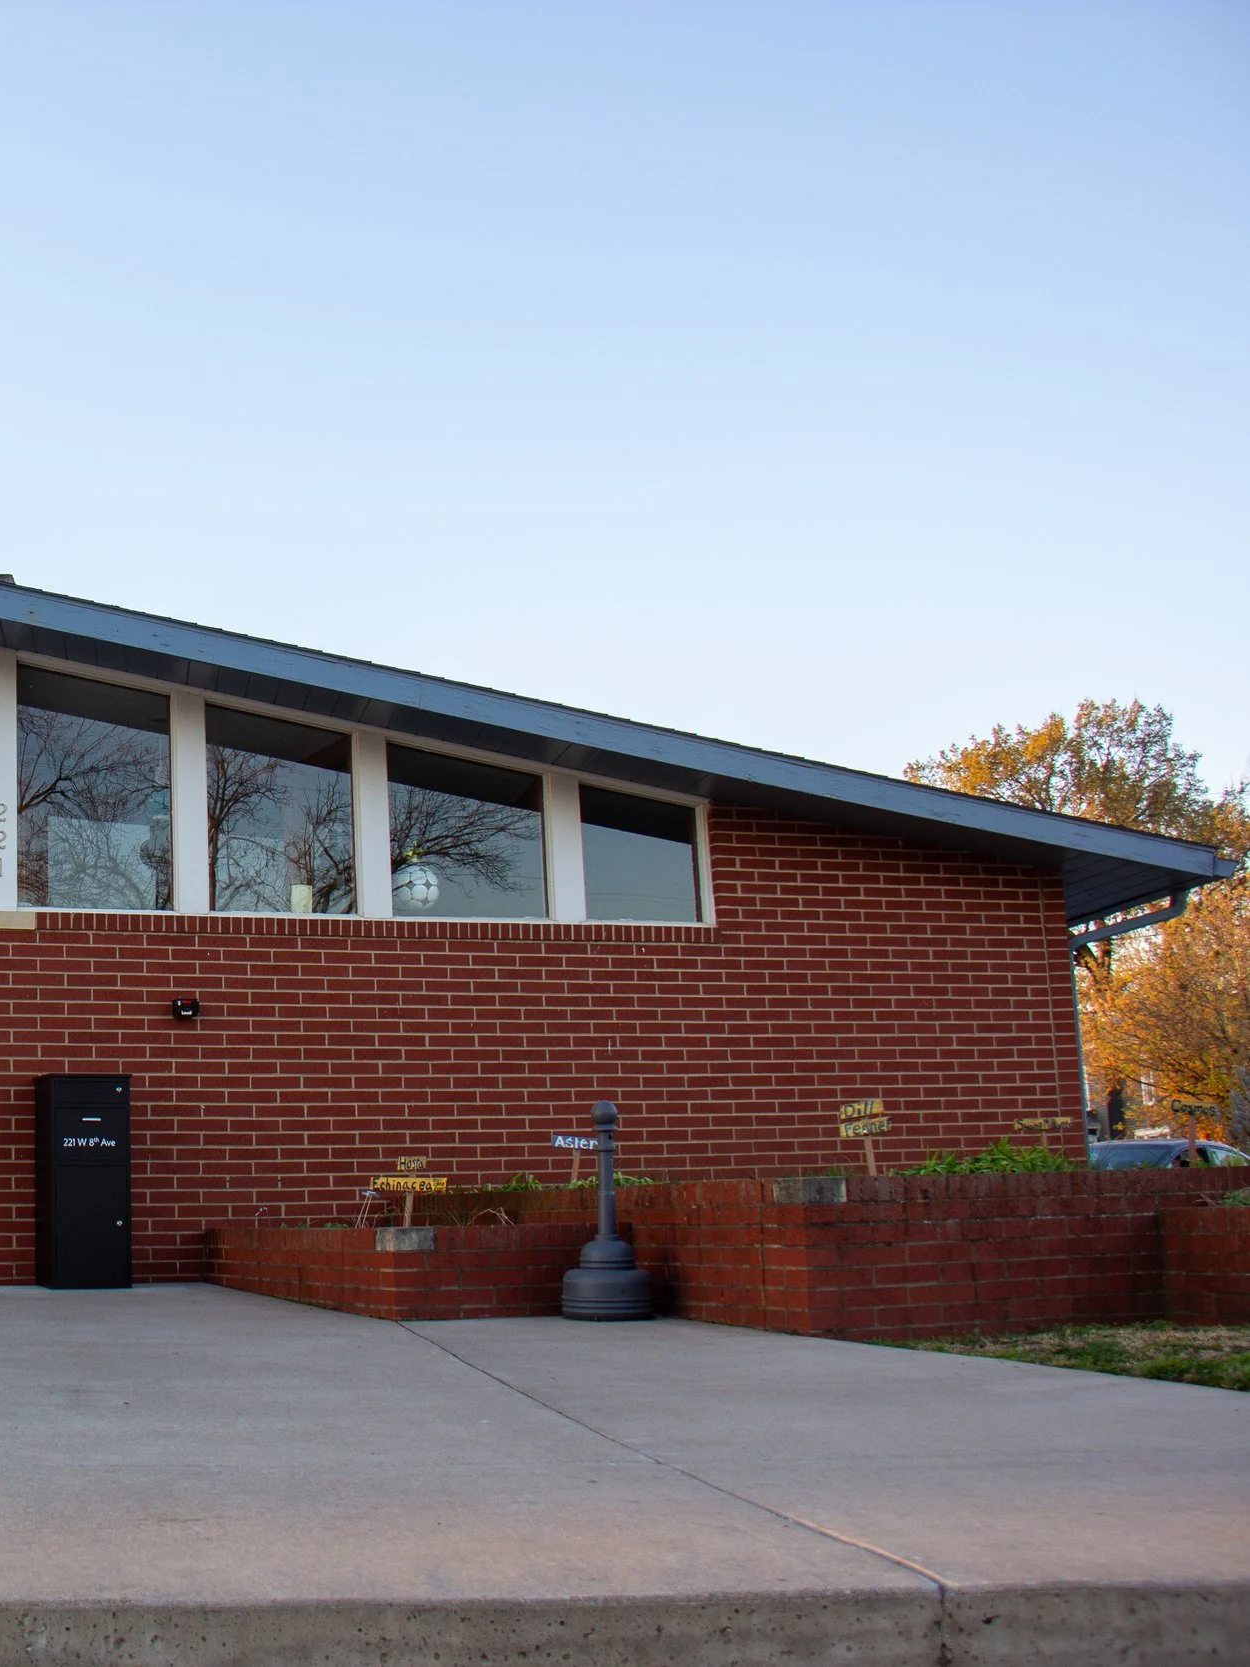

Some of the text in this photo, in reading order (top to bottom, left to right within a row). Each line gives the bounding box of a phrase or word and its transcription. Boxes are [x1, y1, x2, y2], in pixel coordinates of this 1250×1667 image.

[844, 1100, 874, 1118] Dill
[63, 1136, 116, 1147] 221 W 8th Ave
[554, 1135, 598, 1149] Aster
[399, 1157, 424, 1169] Hosta
[372, 1178, 432, 1191] Echinacea
